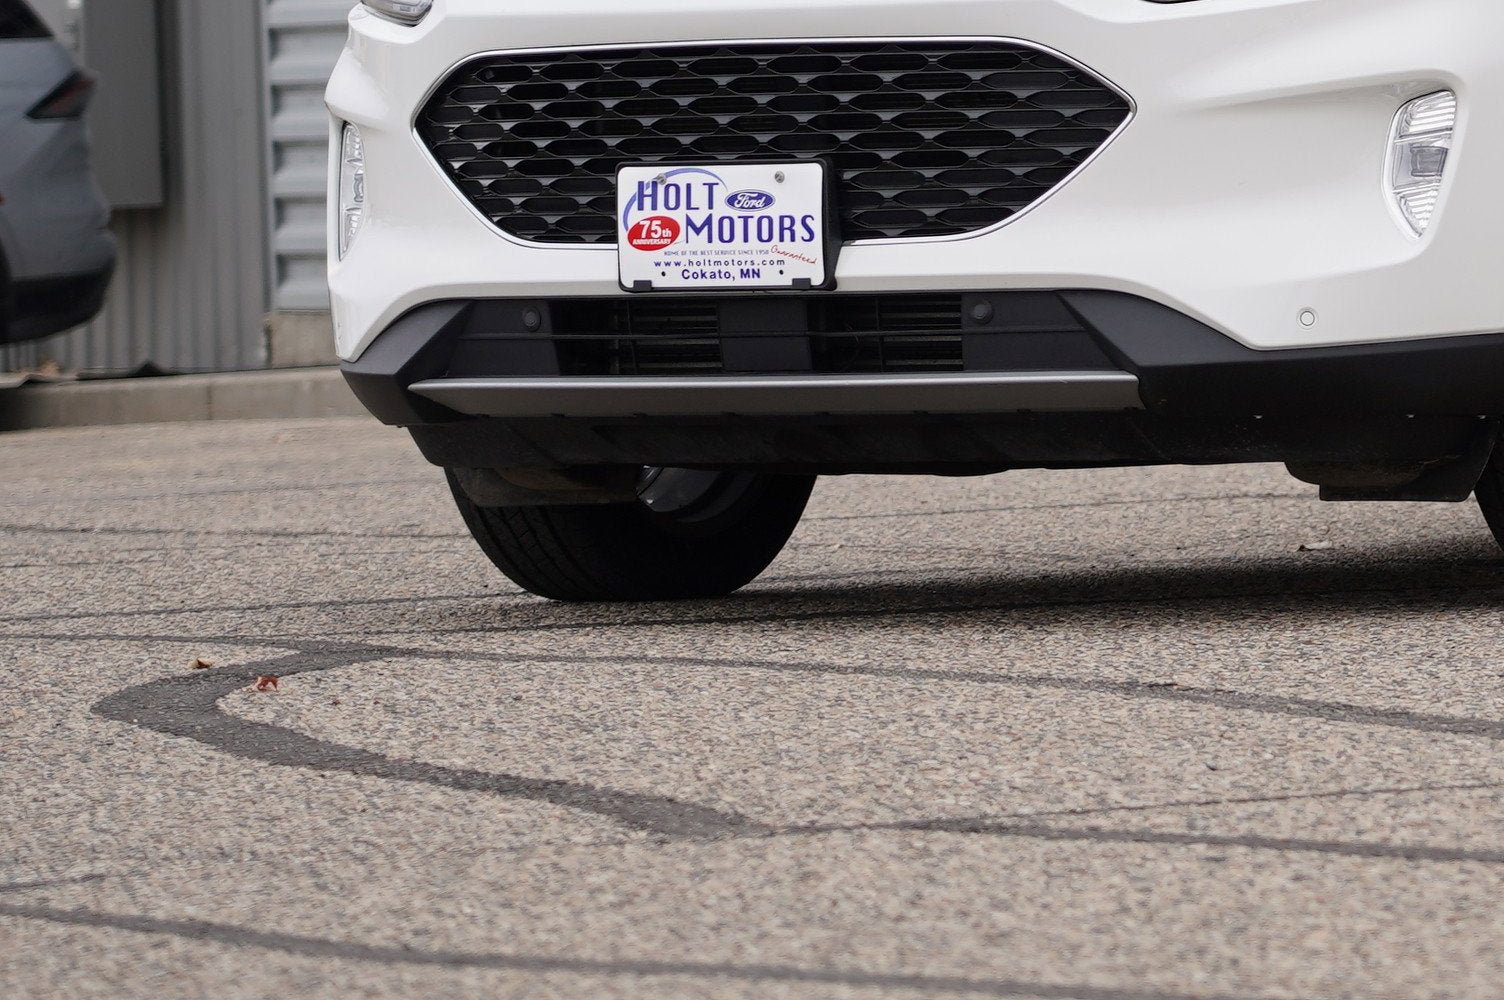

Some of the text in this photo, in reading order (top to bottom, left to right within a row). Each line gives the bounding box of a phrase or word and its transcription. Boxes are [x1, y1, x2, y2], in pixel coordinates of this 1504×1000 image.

[637, 180, 719, 212] HOLT
[733, 191, 768, 209] Ford
[638, 219, 673, 239] 75th
[685, 213, 815, 244] MOTORS
[654, 258, 785, 267] www.holtmotors.com
[681, 268, 761, 281] Cokato, MN
